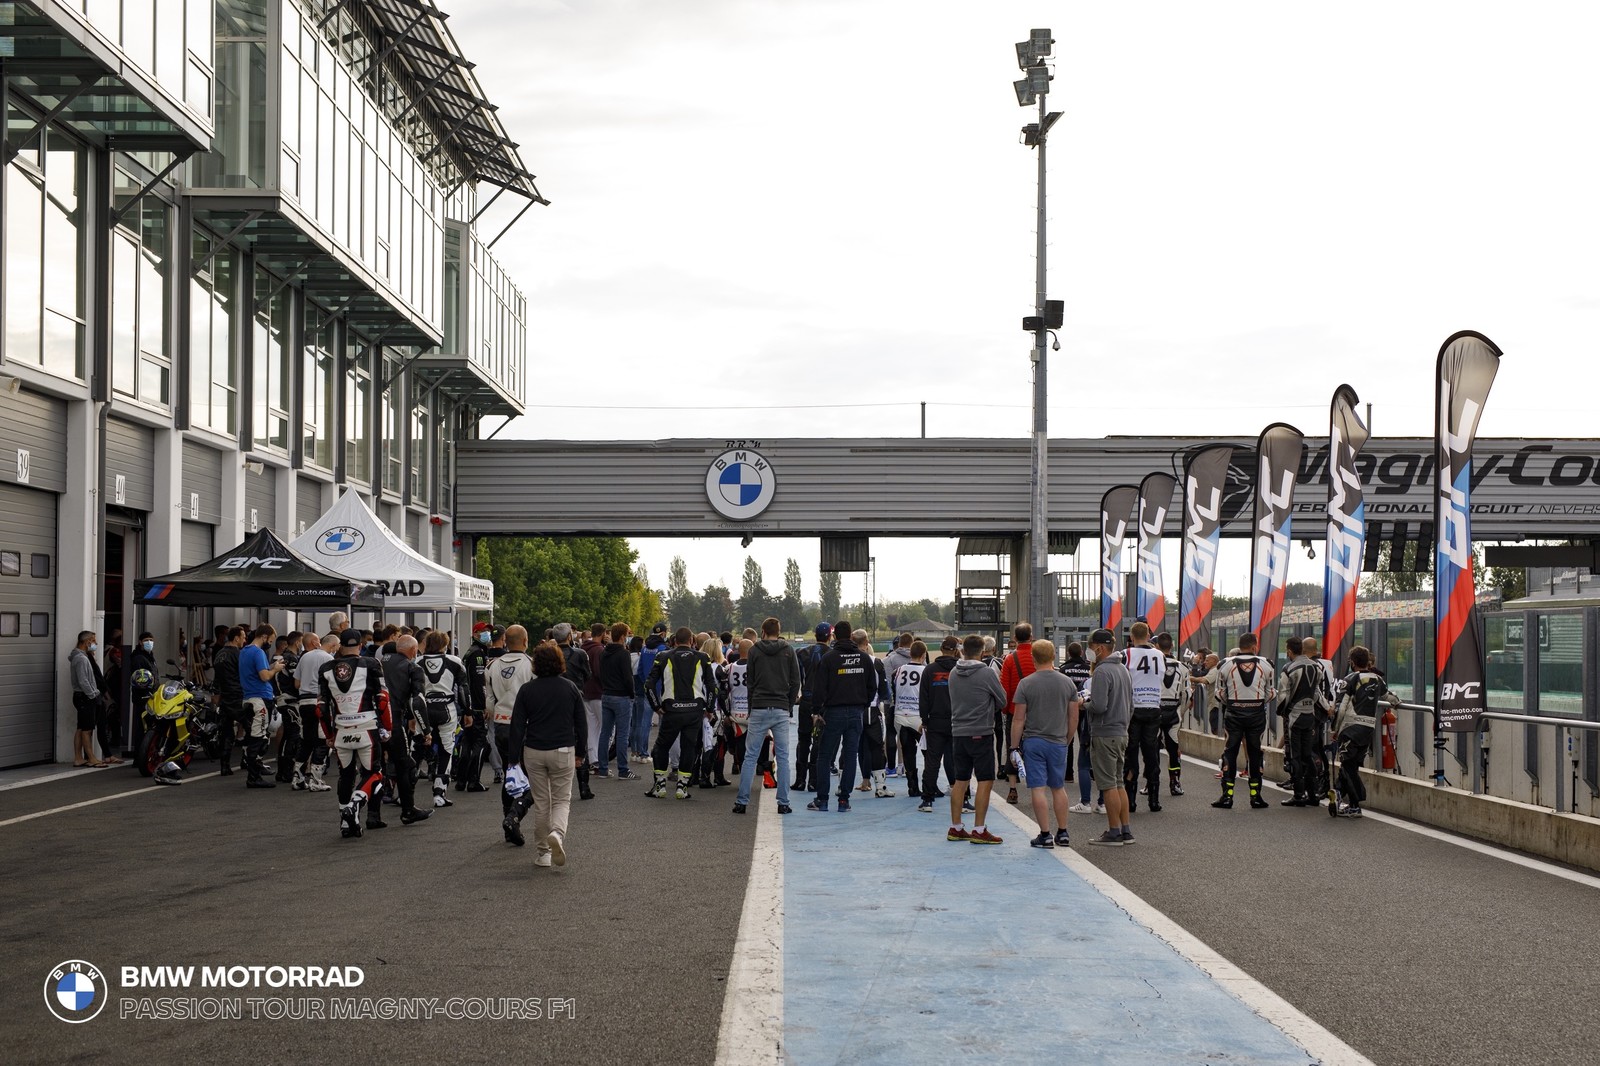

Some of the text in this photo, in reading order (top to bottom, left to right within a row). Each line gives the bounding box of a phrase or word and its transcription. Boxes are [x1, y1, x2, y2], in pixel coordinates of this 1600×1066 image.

[17, 453, 28, 479] 39
[218, 556, 291, 569] BMC
[278, 588, 336, 596] bmc-moto.com
[1136, 655, 1159, 675] 41
[732, 671, 749, 687] 38
[900, 670, 921, 686] 39
[1441, 681, 1481, 700] BMC
